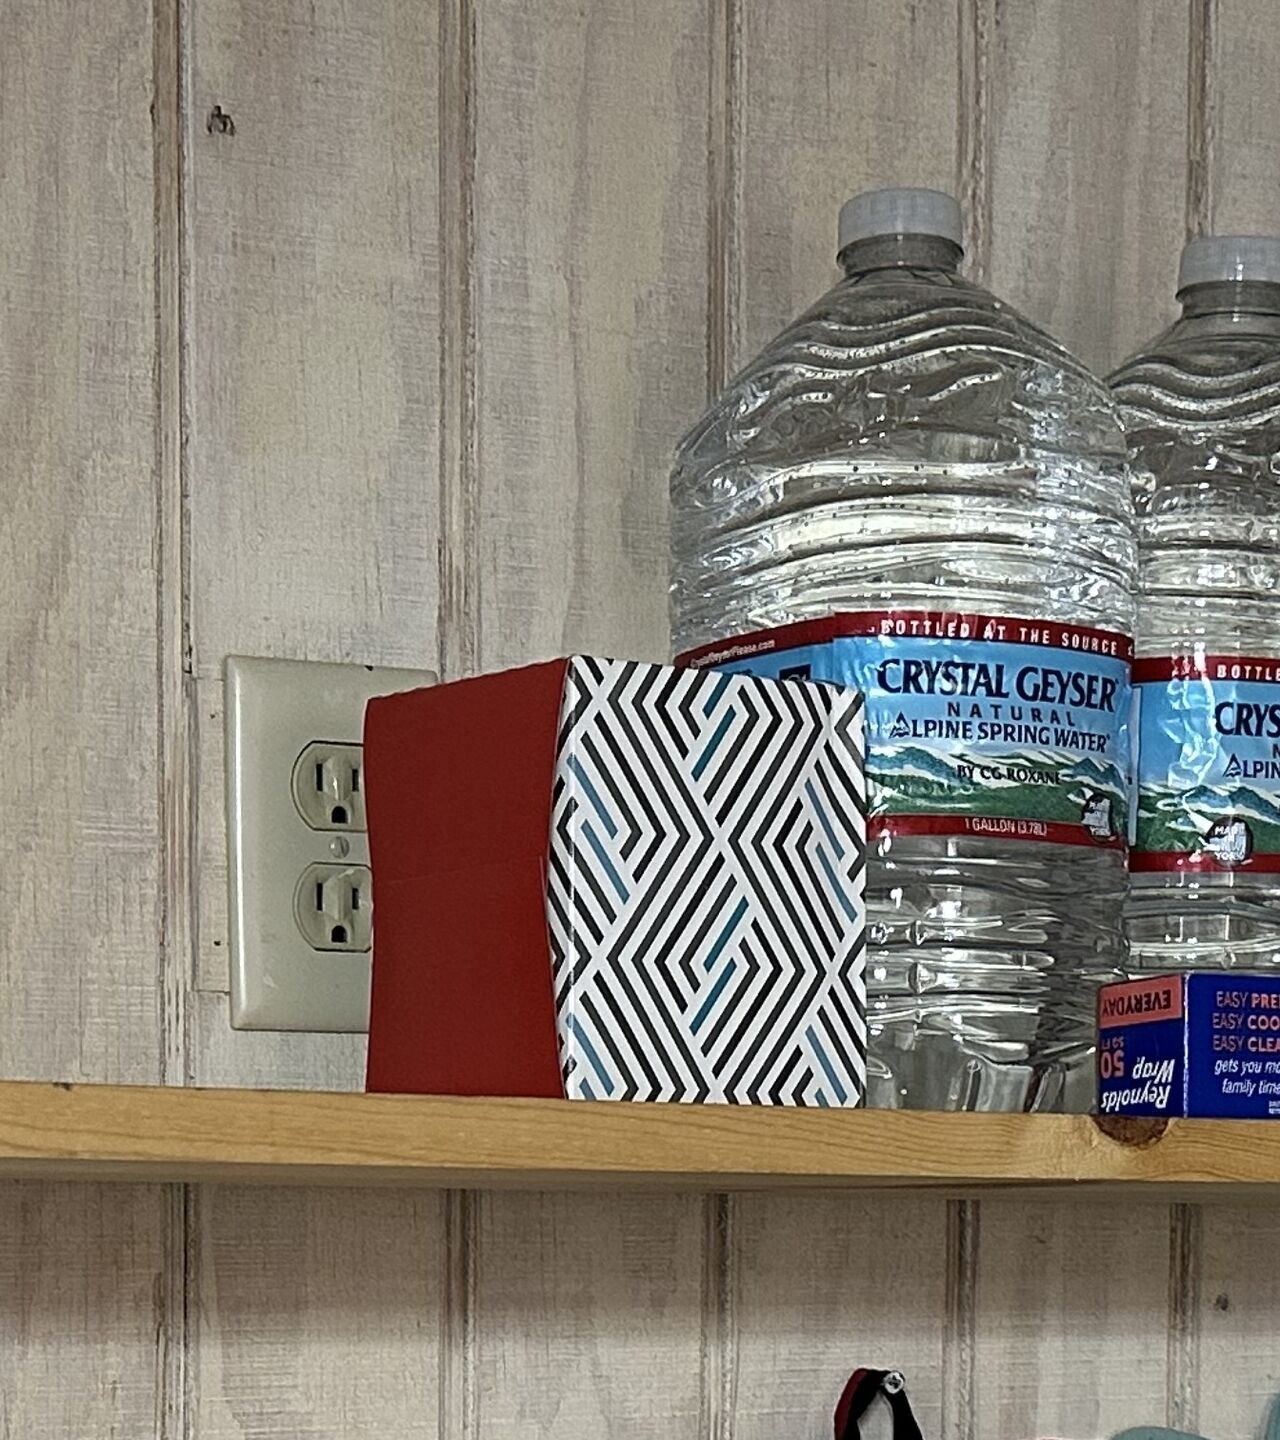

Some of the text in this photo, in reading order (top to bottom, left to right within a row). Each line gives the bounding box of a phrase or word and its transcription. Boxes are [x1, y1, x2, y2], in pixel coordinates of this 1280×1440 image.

[880, 619, 1118, 656] BOTTLED AT THE SOURCE
[877, 658, 1117, 713] CRYSTAL GEYSER
[947, 701, 1077, 728] NATURAL
[889, 711, 1109, 753] ALPINE SPRING WATER
[957, 765, 1061, 785] BY CG ROXANE
[964, 818, 970, 829] 1
[972, 818, 1016, 833] GALLON
[1101, 988, 1171, 1017] EVERYDAY
[1216, 991, 1248, 1008] EASY
[1212, 1012, 1243, 1029] EASY
[1101, 1037, 1125, 1050] SQ FT
[1212, 1035, 1243, 1051] EASY
[1101, 1052, 1125, 1079] 50
[1132, 1057, 1175, 1085] Wrap
[1214, 1058, 1239, 1075] gets
[1240, 1062, 1262, 1076] you
[1101, 1081, 1171, 1112] Reynolds
[1222, 1078, 1256, 1097] family
